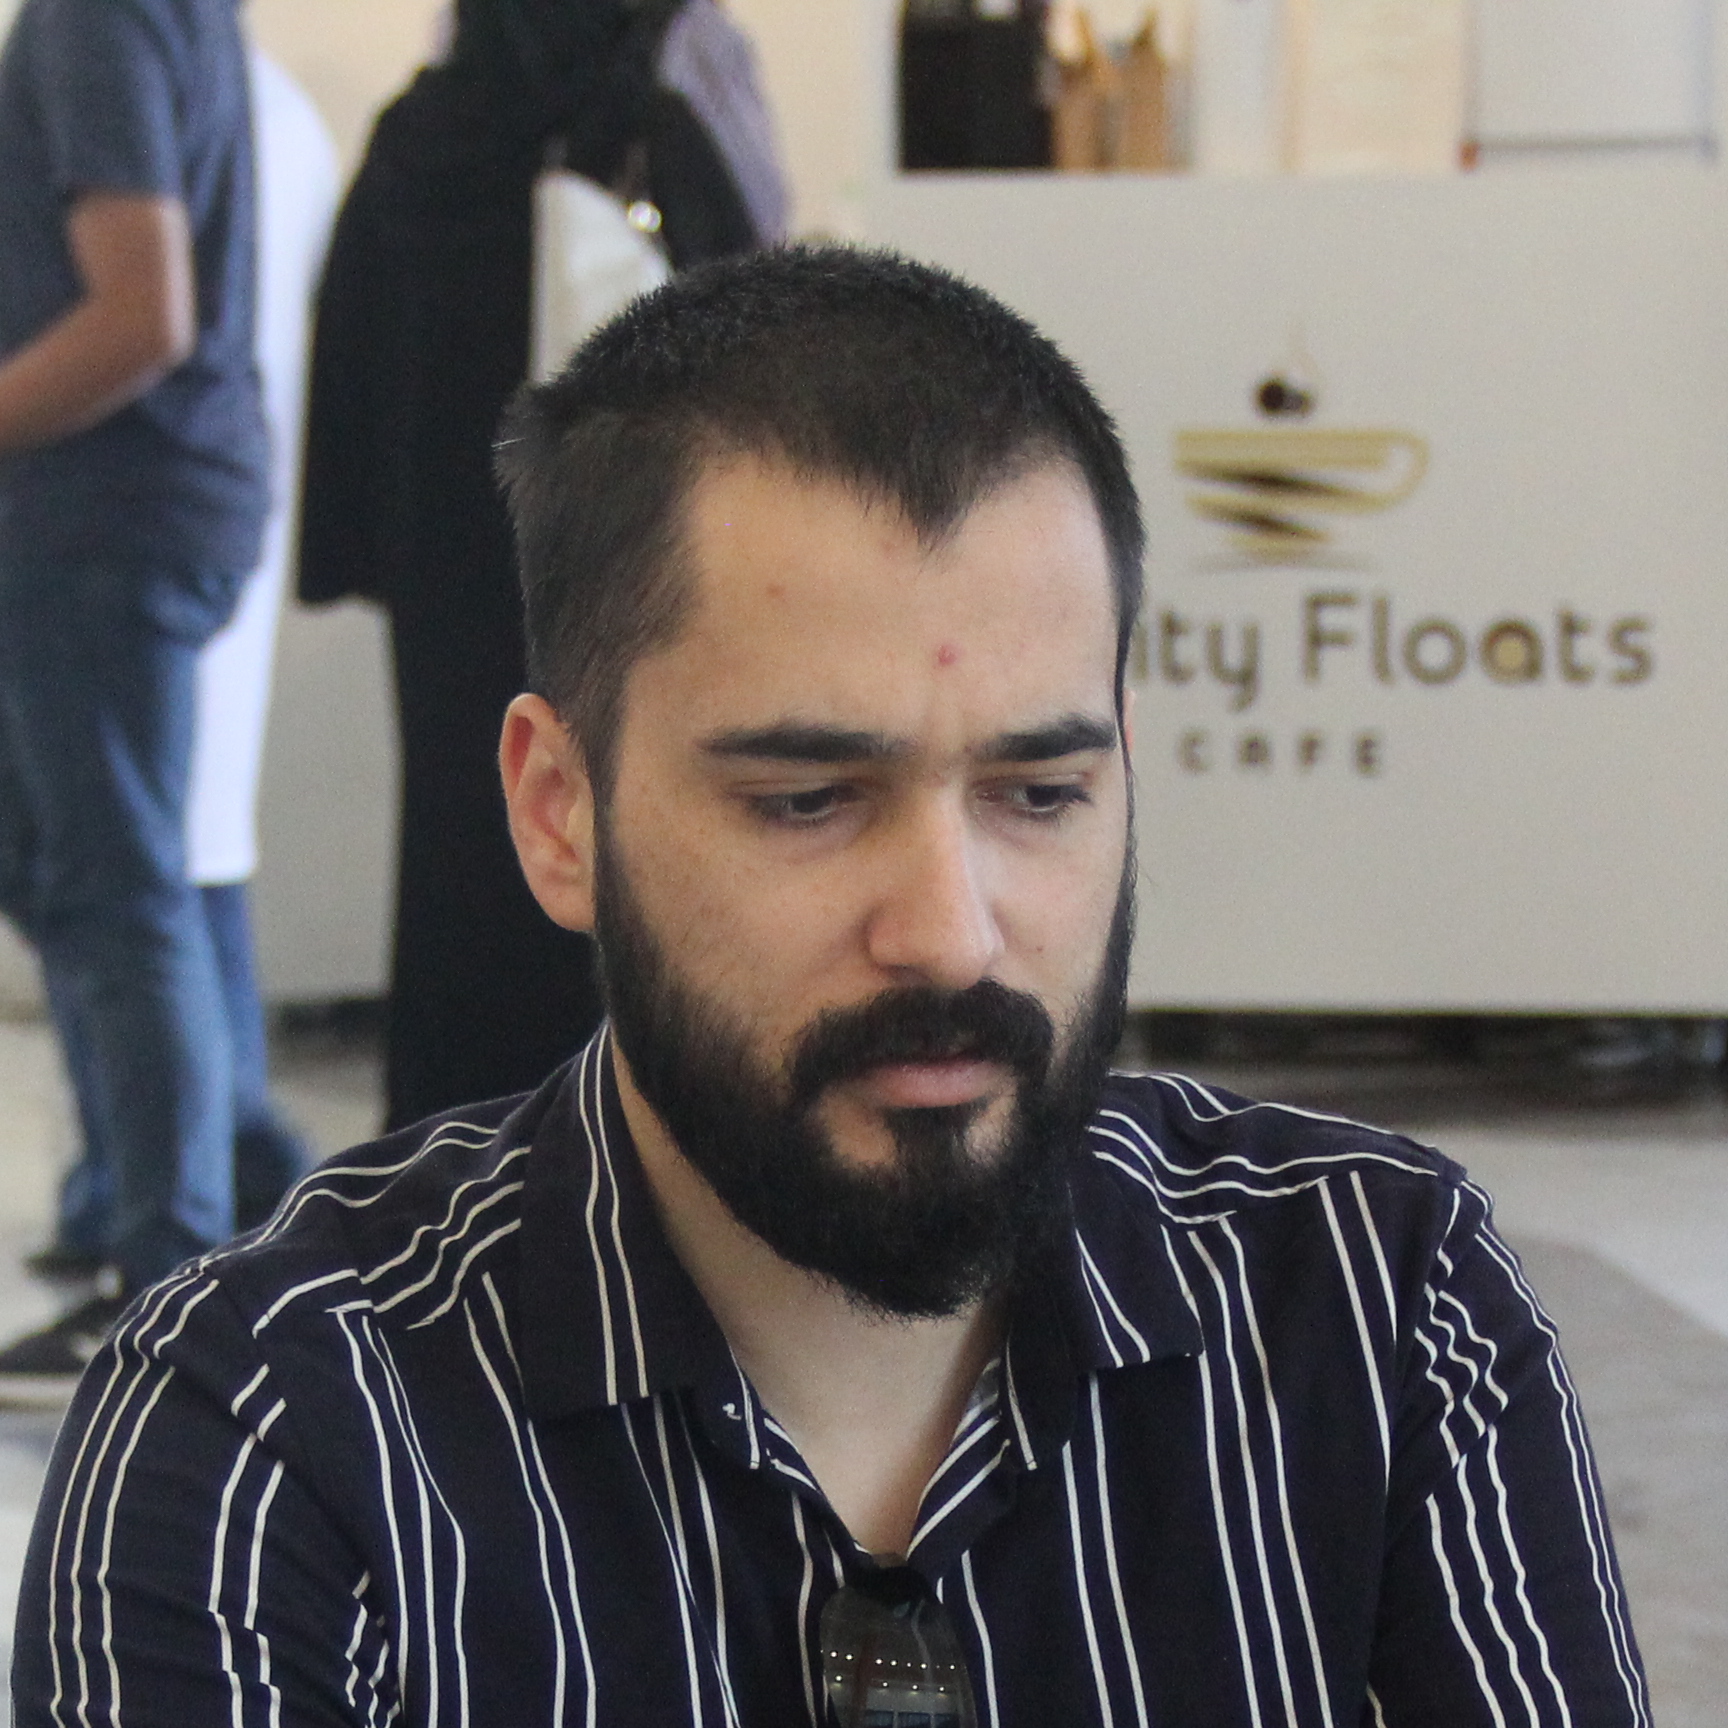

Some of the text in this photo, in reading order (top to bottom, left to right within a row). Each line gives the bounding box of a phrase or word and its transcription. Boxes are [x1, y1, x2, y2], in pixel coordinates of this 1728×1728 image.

[1132, 589, 1656, 714] ity Floats
[1176, 728, 1380, 774] CAFE
